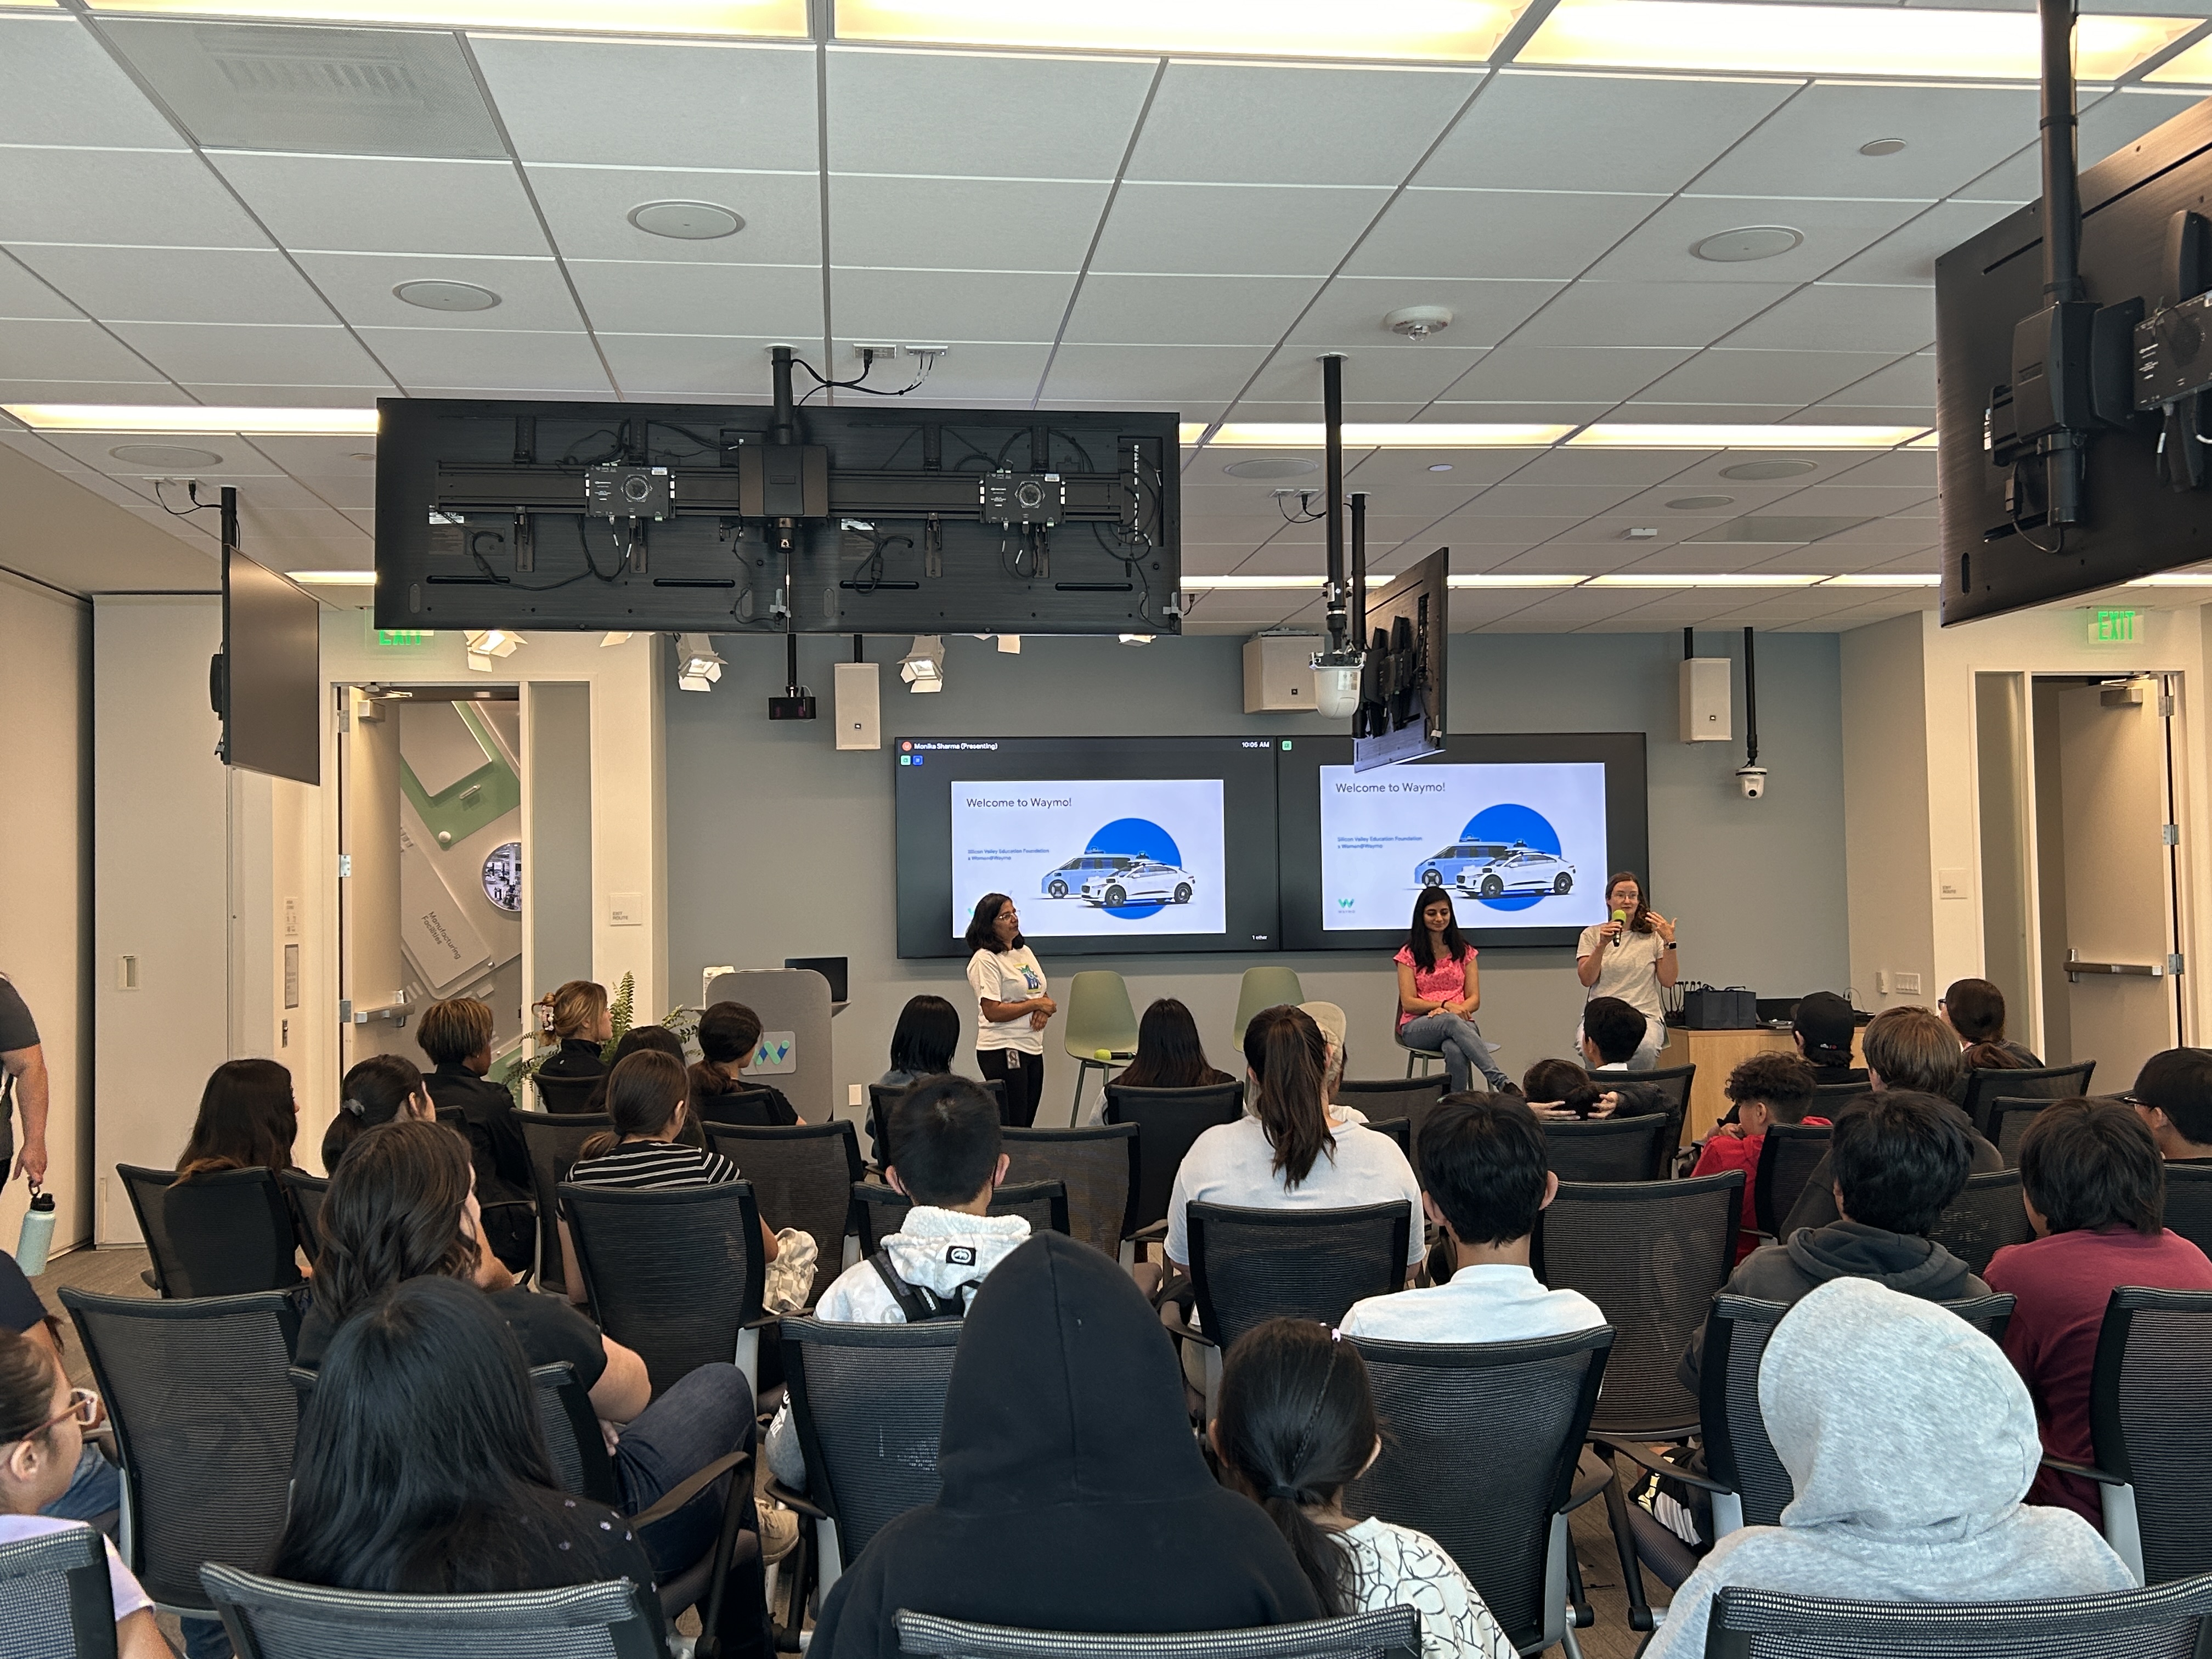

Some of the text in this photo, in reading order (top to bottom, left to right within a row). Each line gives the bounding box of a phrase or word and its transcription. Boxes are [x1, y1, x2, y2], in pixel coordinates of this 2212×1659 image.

[2098, 611, 2135, 641] EXIT
[961, 742, 998, 751] (Presenting)
[1336, 782, 1446, 794] Welcome to Waymo!
[967, 797, 1072, 809] Welcome to Waymo!
[428, 911, 461, 960] Manufacturing
